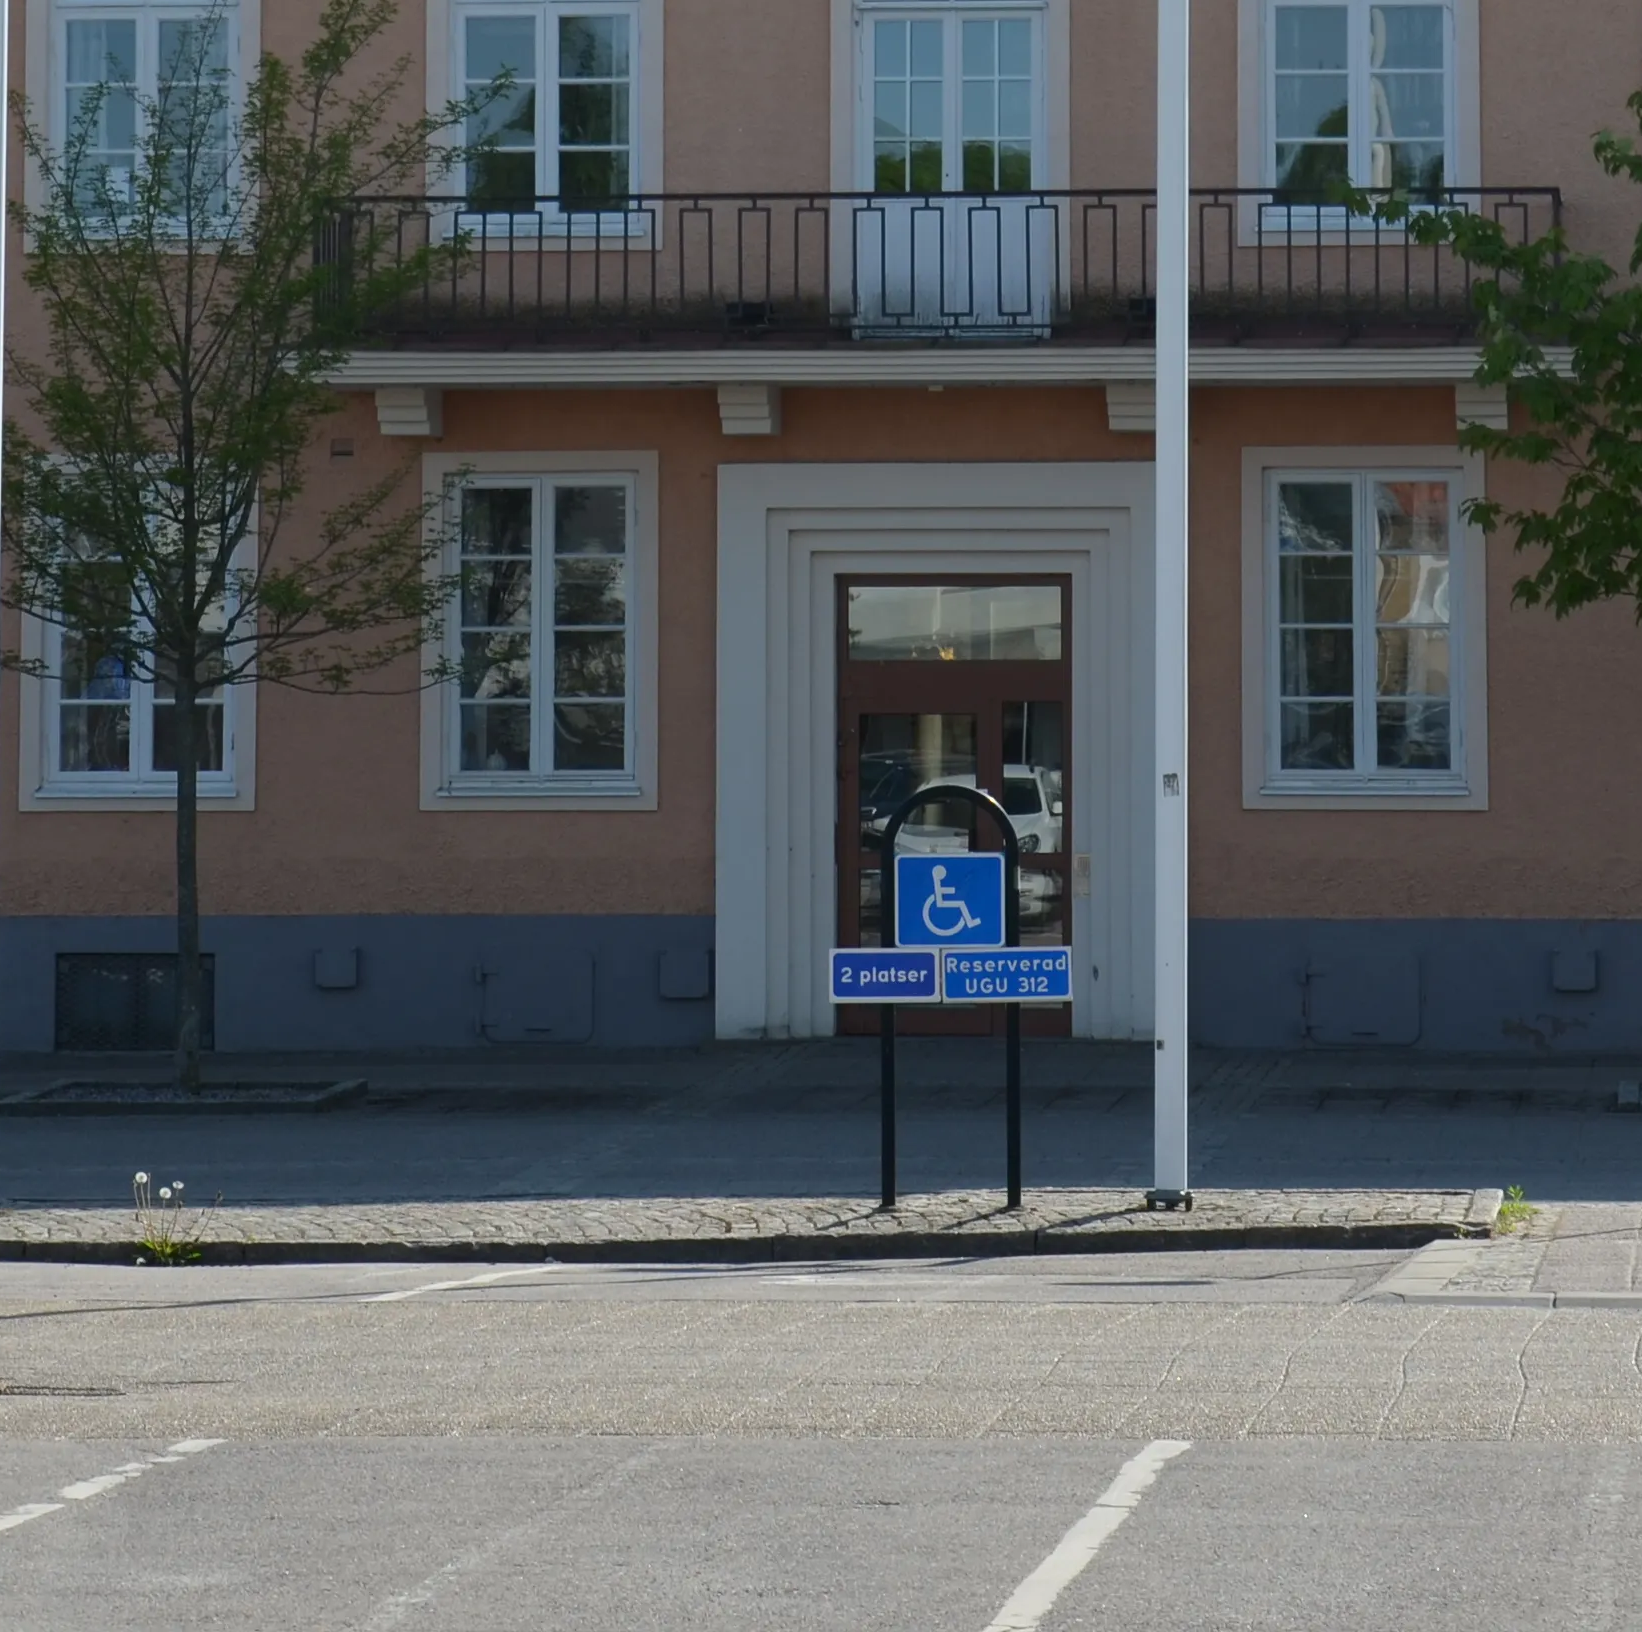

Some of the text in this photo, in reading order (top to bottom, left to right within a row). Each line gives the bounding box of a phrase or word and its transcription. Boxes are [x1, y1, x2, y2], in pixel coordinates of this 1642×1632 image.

[946, 954, 1067, 973] Reserverad
[840, 966, 928, 987] 2 platser
[965, 976, 1049, 994] UGU 312
